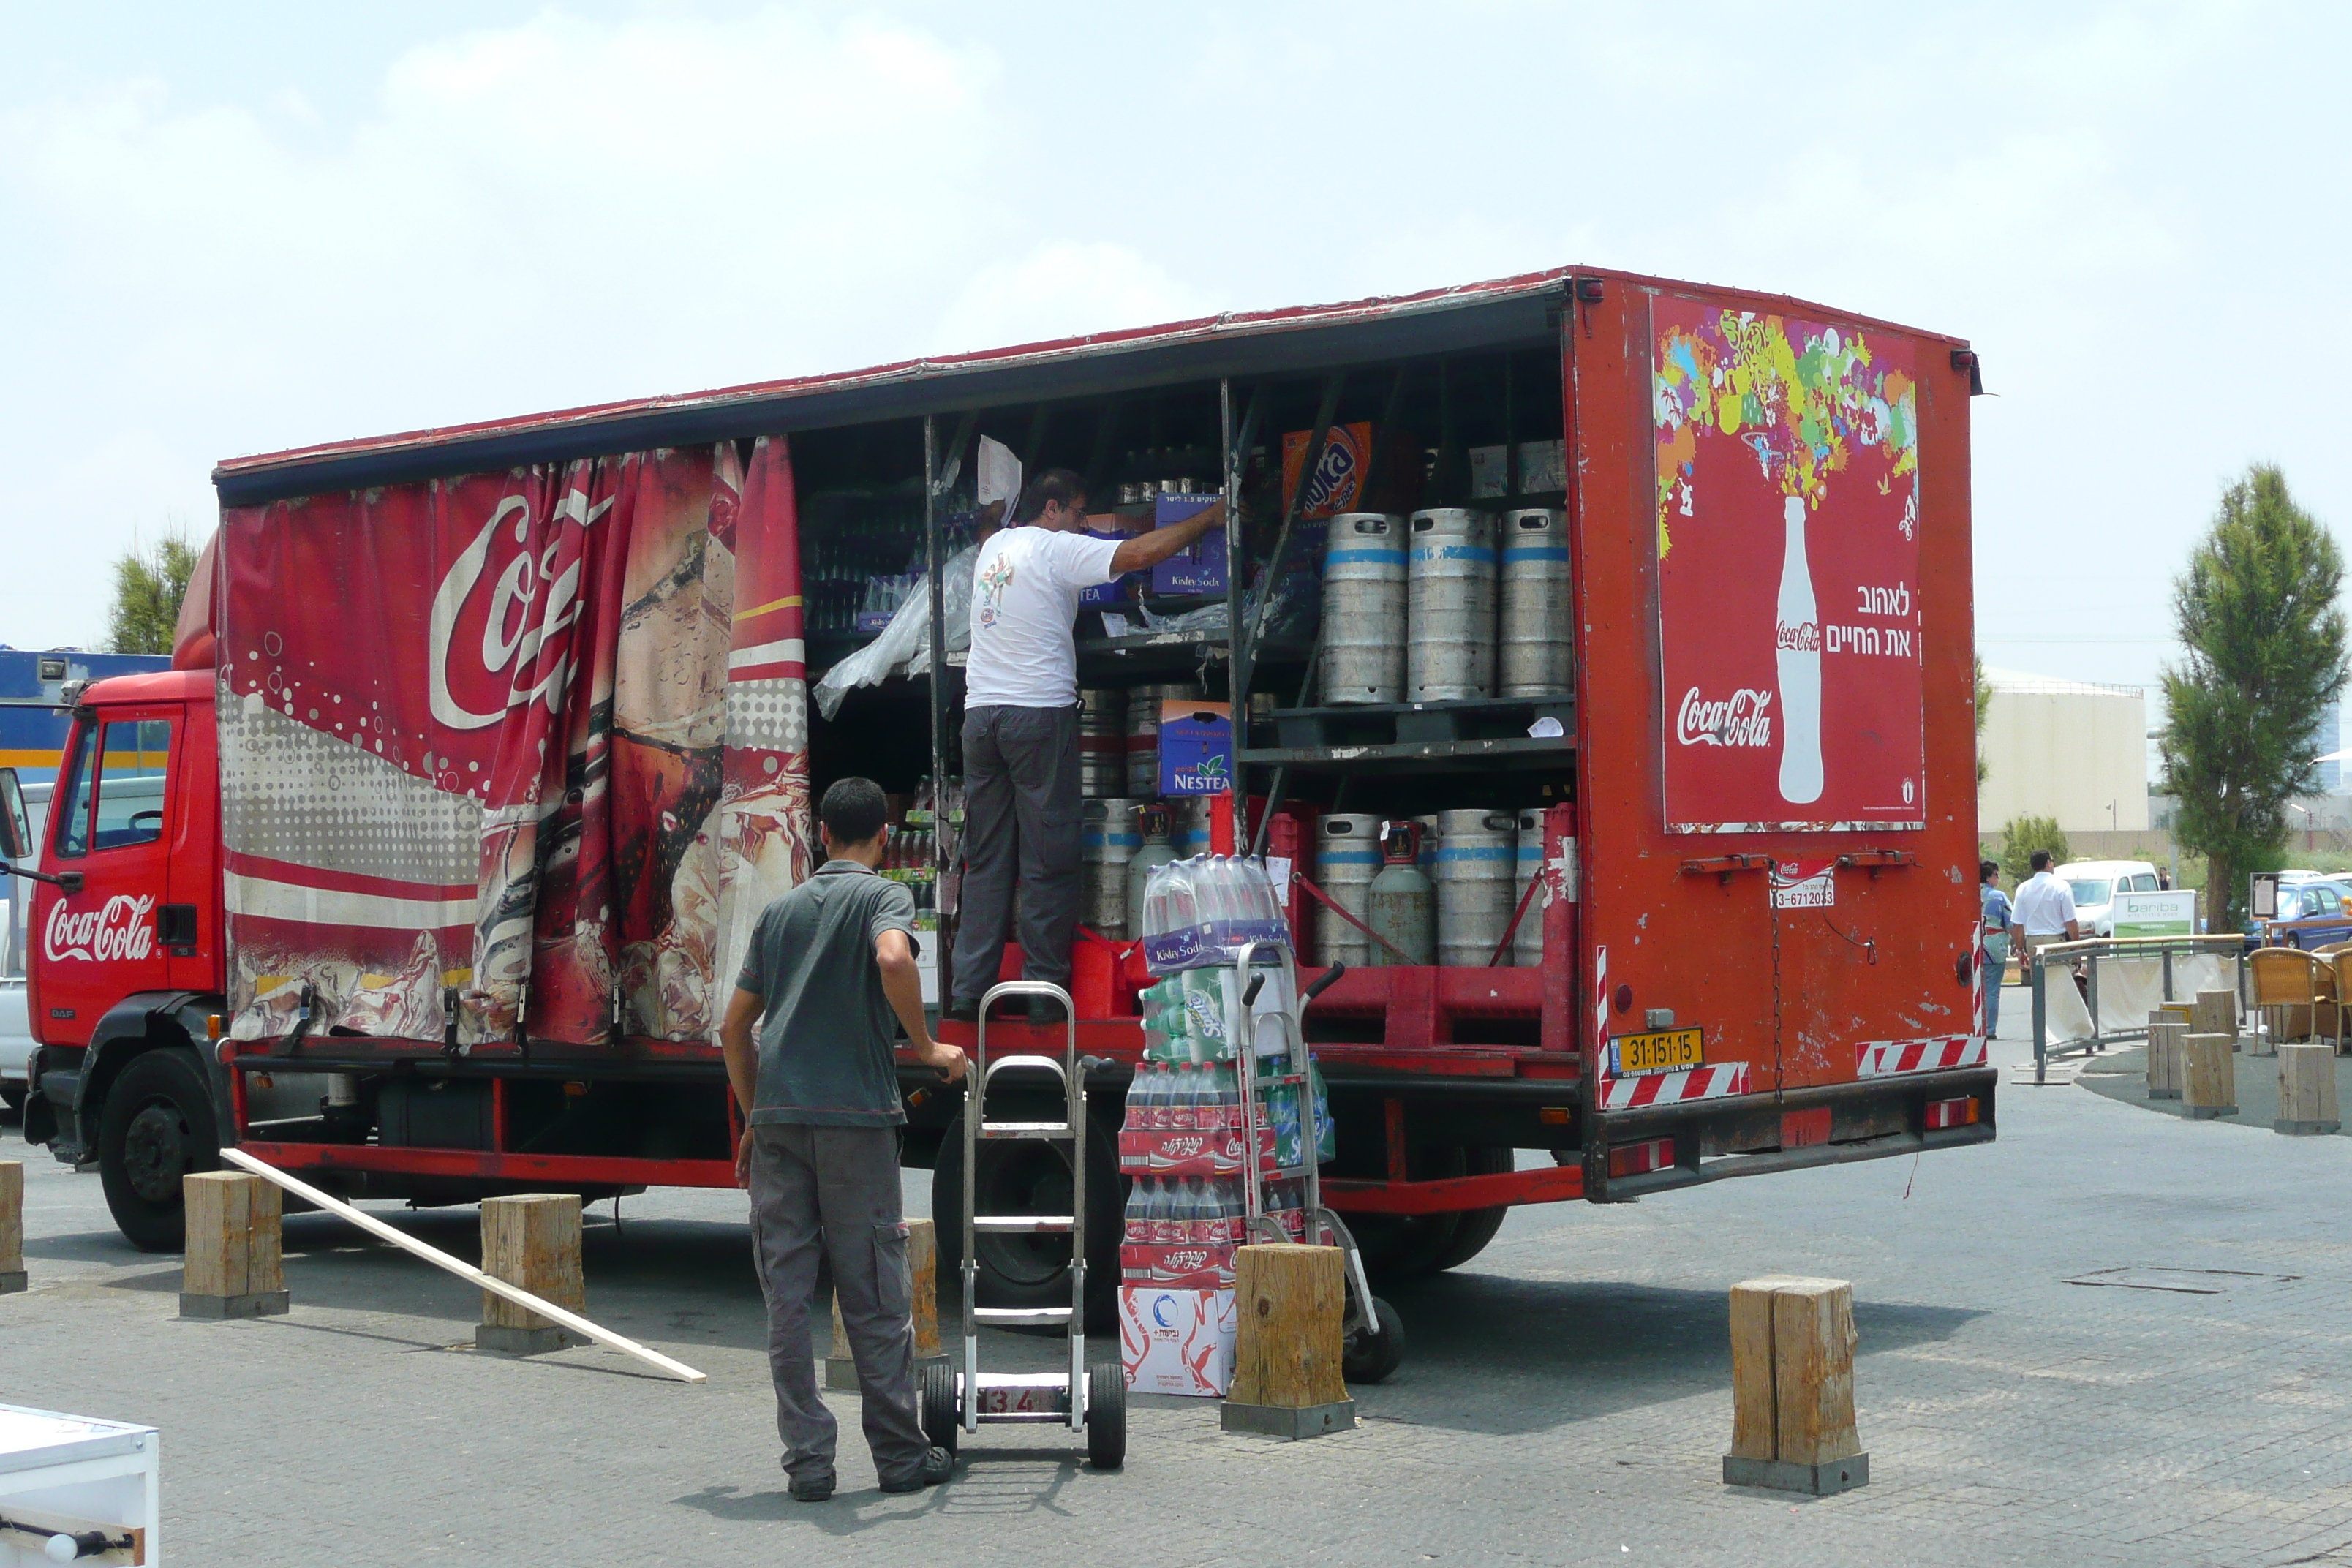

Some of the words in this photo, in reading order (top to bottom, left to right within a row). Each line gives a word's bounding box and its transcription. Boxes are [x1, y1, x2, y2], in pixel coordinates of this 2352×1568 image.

[1079, 588, 1101, 602] TEA
[1858, 581, 1910, 617] לאהוב
[1776, 620, 1820, 652] Coca-Cola
[1826, 625, 1880, 655] החיים
[1885, 628, 1911, 657] את
[1677, 687, 1772, 747] Coca-Cola
[1175, 774, 1230, 790] NESTEA
[1772, 892, 1833, 907] 3-671203
[2127, 897, 2178, 913] bariba
[45, 894, 156, 962] Coca-Cola
[51, 1009, 74, 1018] DAF
[1191, 995, 1223, 1038] Sprite
[990, 1389, 1034, 1414] 34
